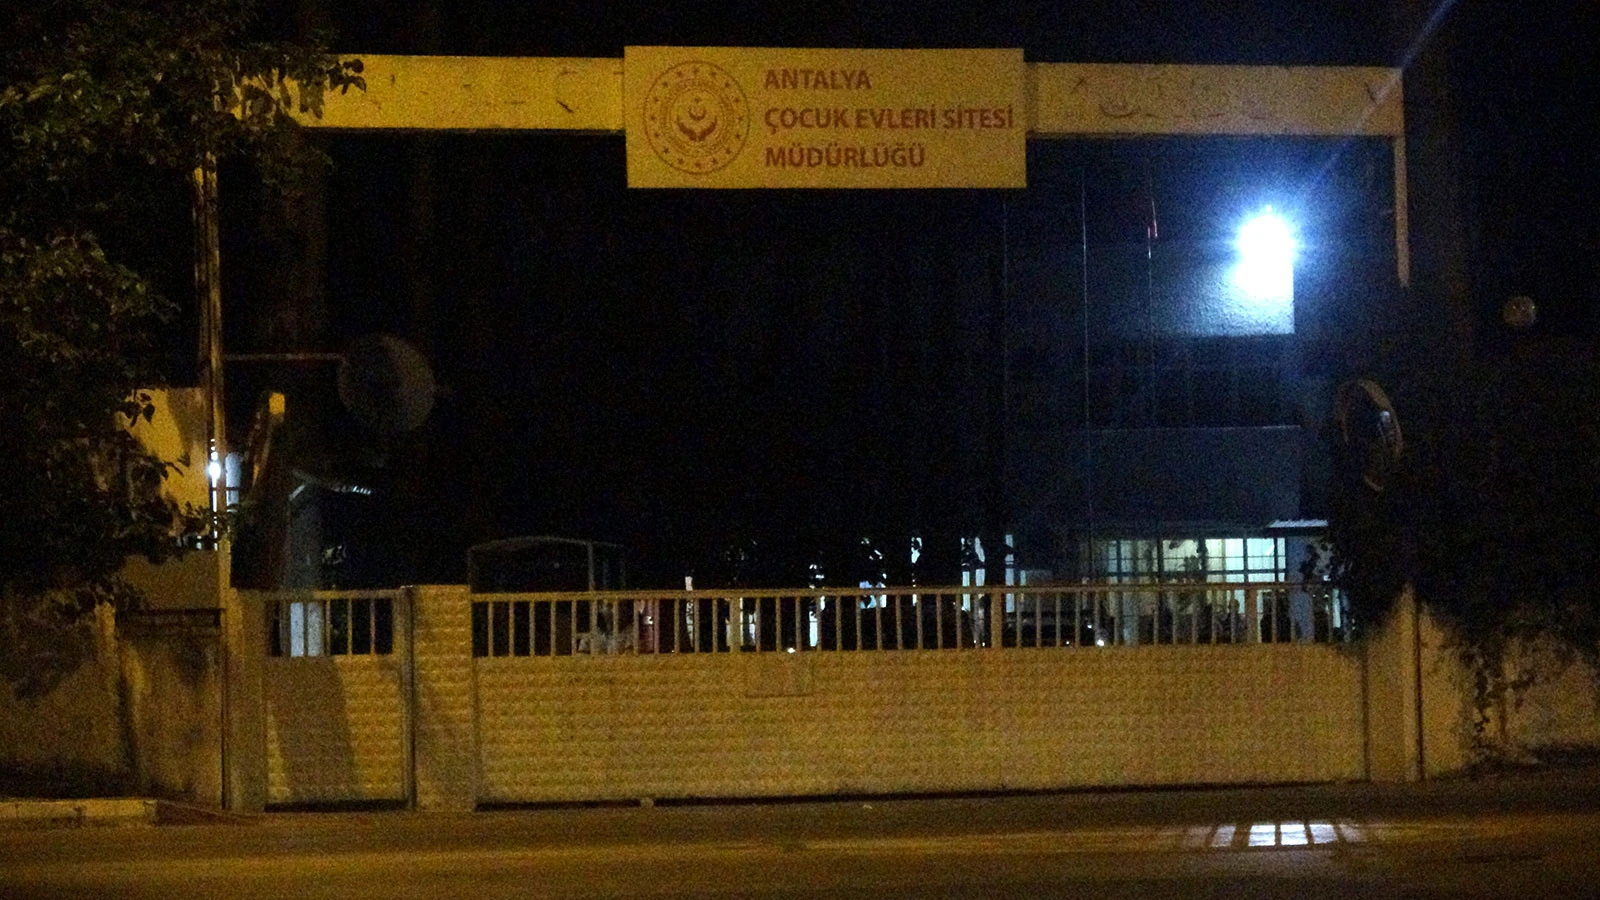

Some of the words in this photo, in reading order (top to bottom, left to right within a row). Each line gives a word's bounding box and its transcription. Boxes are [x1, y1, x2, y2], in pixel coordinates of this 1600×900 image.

[764, 68, 872, 91] ANTALYA
[764, 107, 850, 133] ÇOCUK
[855, 105, 936, 129] EVLERİ
[943, 105, 1014, 129] SİTESİ
[764, 143, 926, 168] MÜDÜRLÜĞÜ
